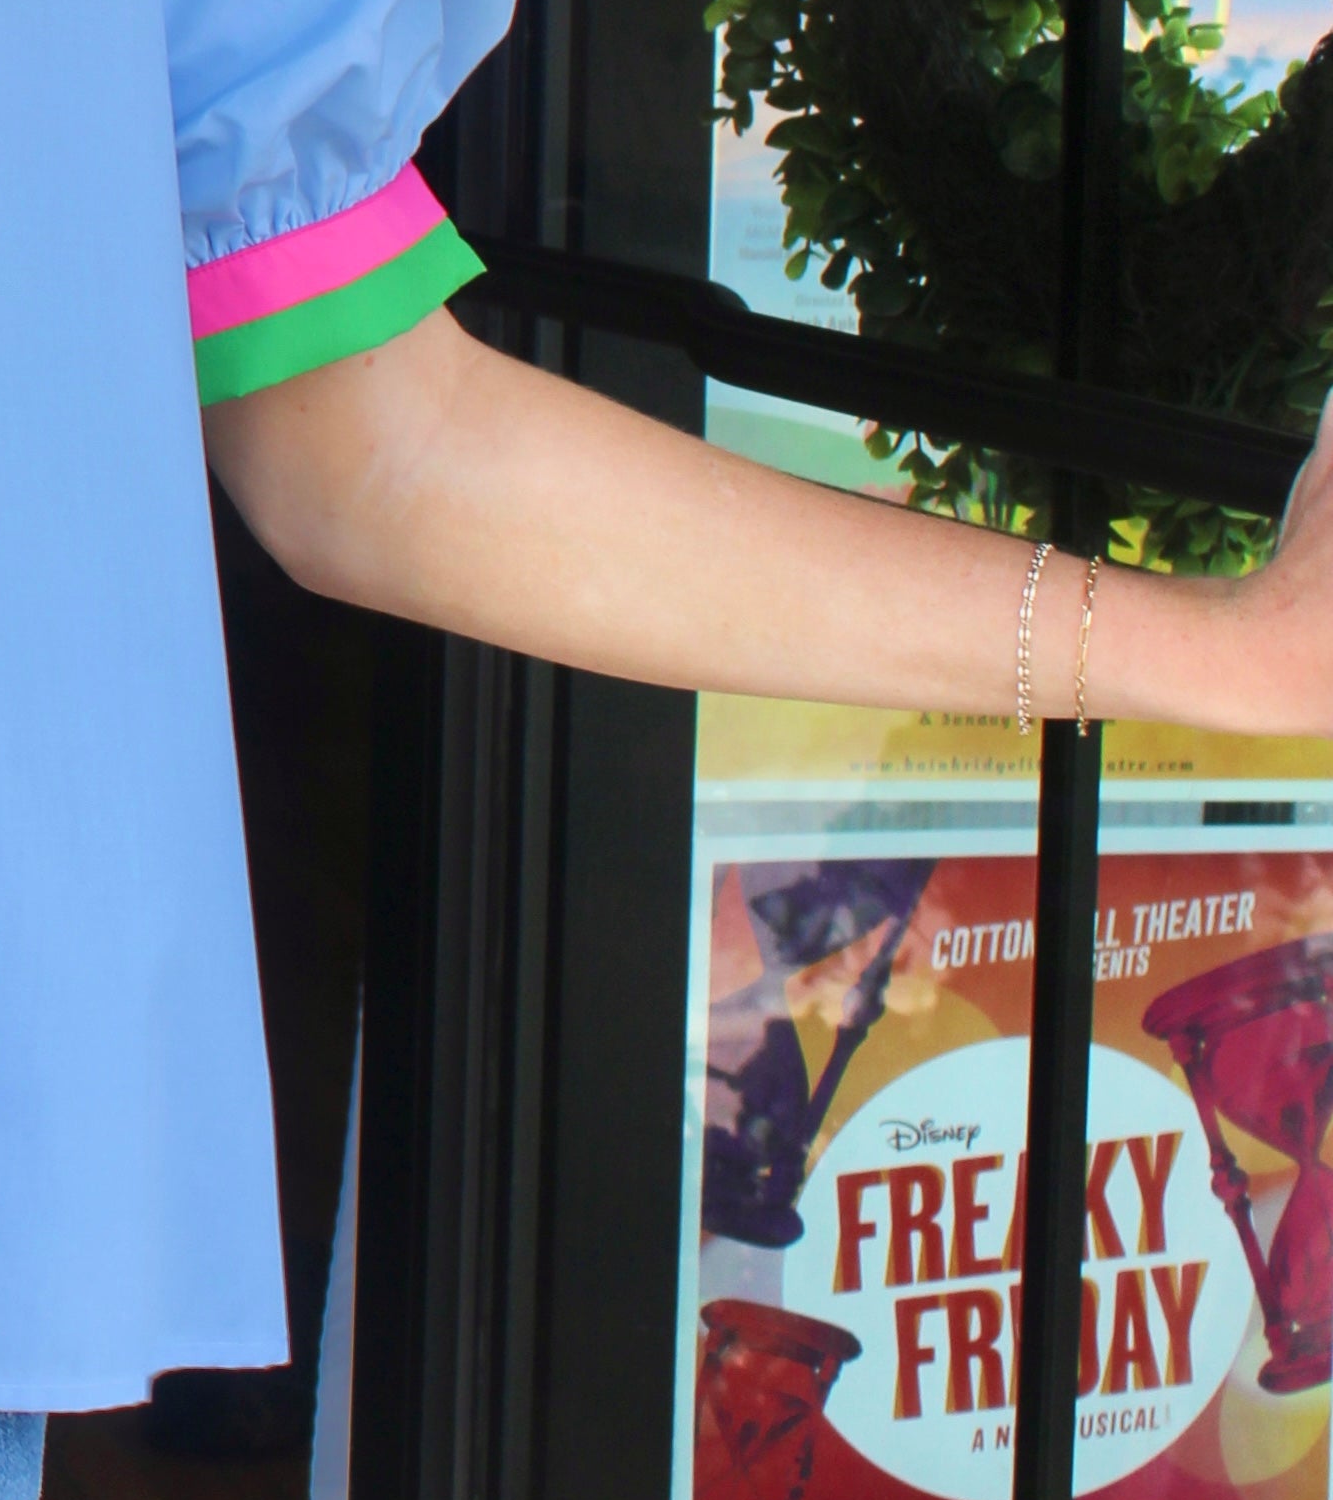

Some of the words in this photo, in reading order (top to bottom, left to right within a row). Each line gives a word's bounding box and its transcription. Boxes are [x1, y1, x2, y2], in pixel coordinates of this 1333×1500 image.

[1132, 891, 1256, 947] THEATER
[879, 1118, 982, 1152] Disney
[972, 1427, 985, 1453] A
[1079, 1405, 1161, 1441] USICAL
